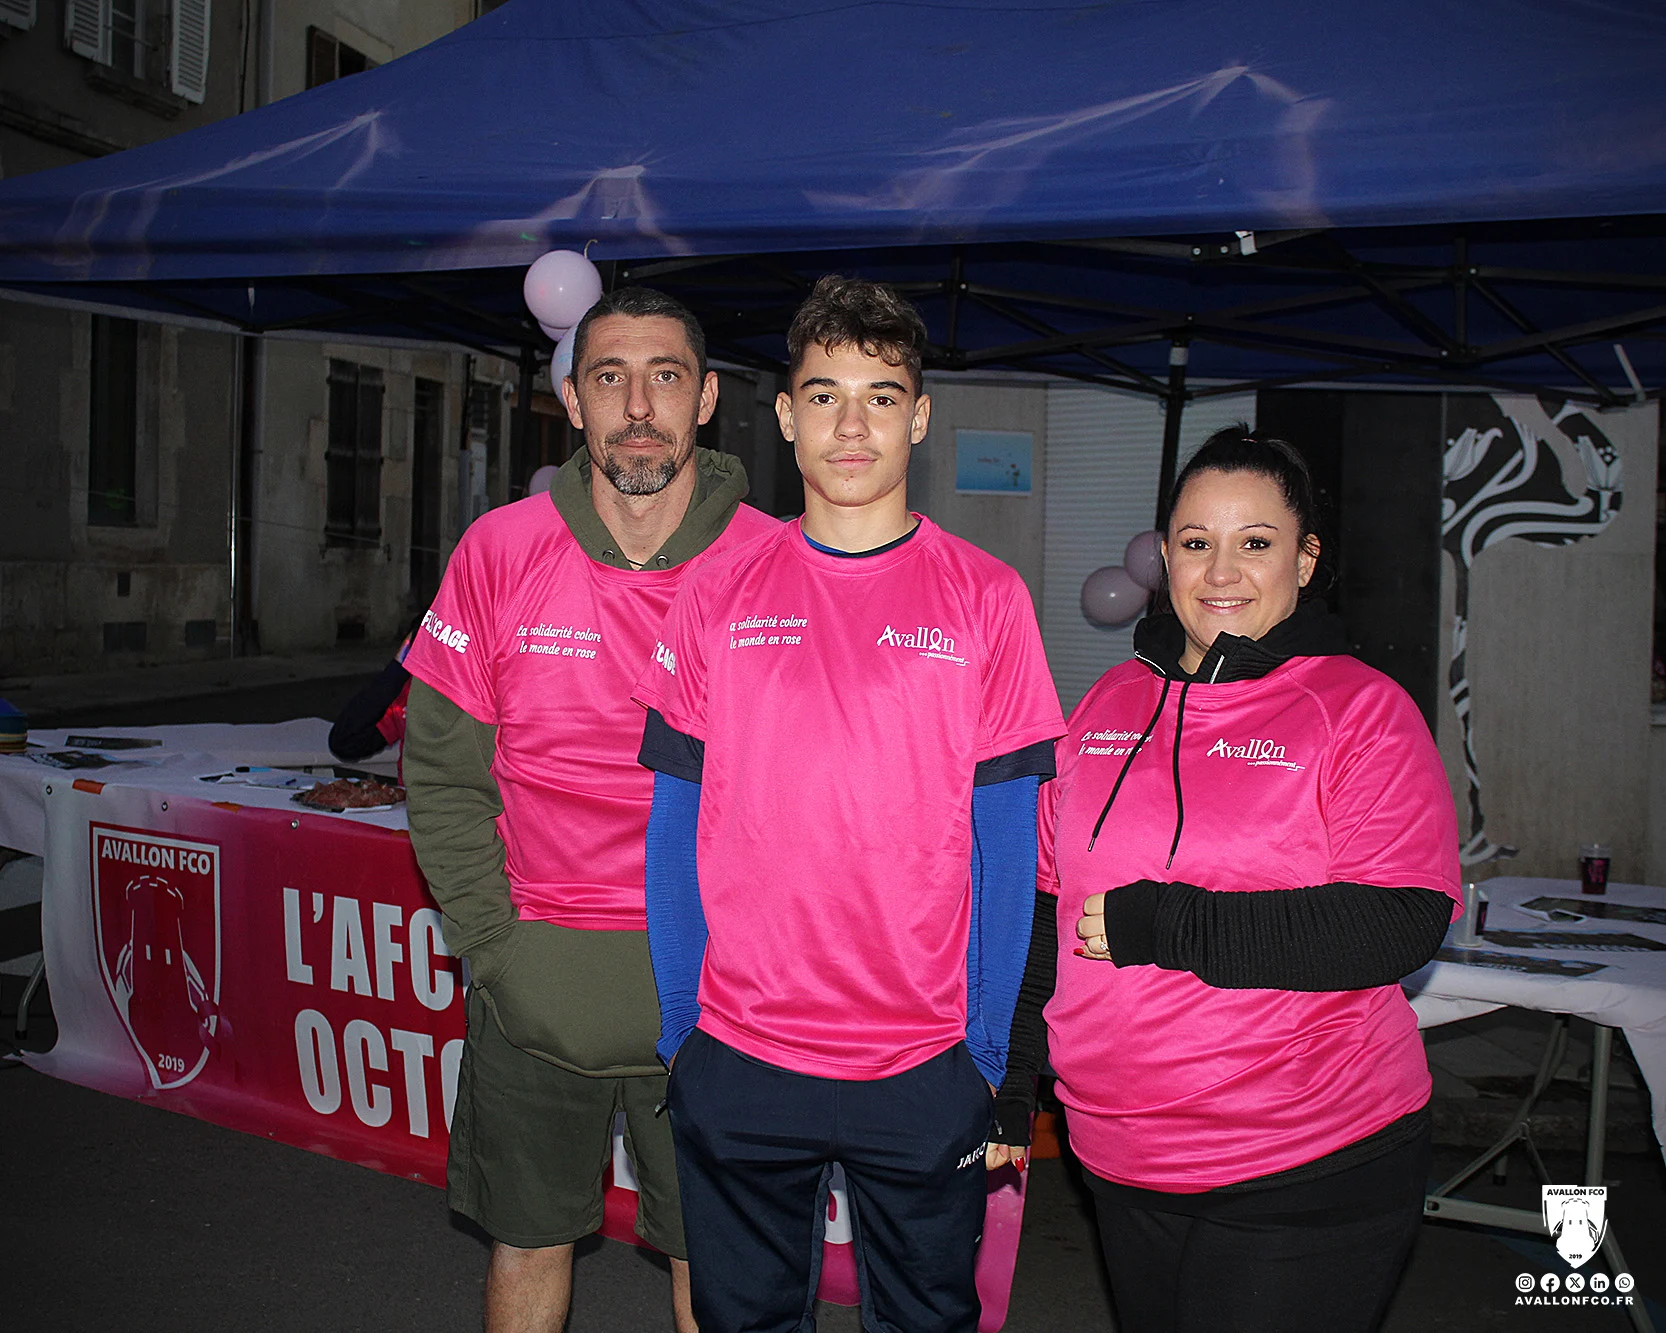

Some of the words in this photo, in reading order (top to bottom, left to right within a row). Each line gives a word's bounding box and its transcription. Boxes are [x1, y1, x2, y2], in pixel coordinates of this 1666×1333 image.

[529, 623, 573, 639] solidarité
[737, 614, 779, 631] solidarité
[779, 613, 808, 628] colore
[519, 640, 528, 654] le
[528, 641, 561, 656] monde
[561, 646, 574, 657] en
[575, 648, 597, 660] rose
[729, 635, 737, 649] le
[737, 631, 766, 648] monde
[767, 634, 780, 645] en
[781, 634, 802, 645] rose
[1084, 744, 1115, 756] monde
[101, 838, 175, 870] AVALLON
[178, 850, 211, 875] FCO
[283, 887, 472, 1011] L'AFC
[158, 1052, 185, 1073] 2019
[956, 1141, 987, 1169] JAKO
